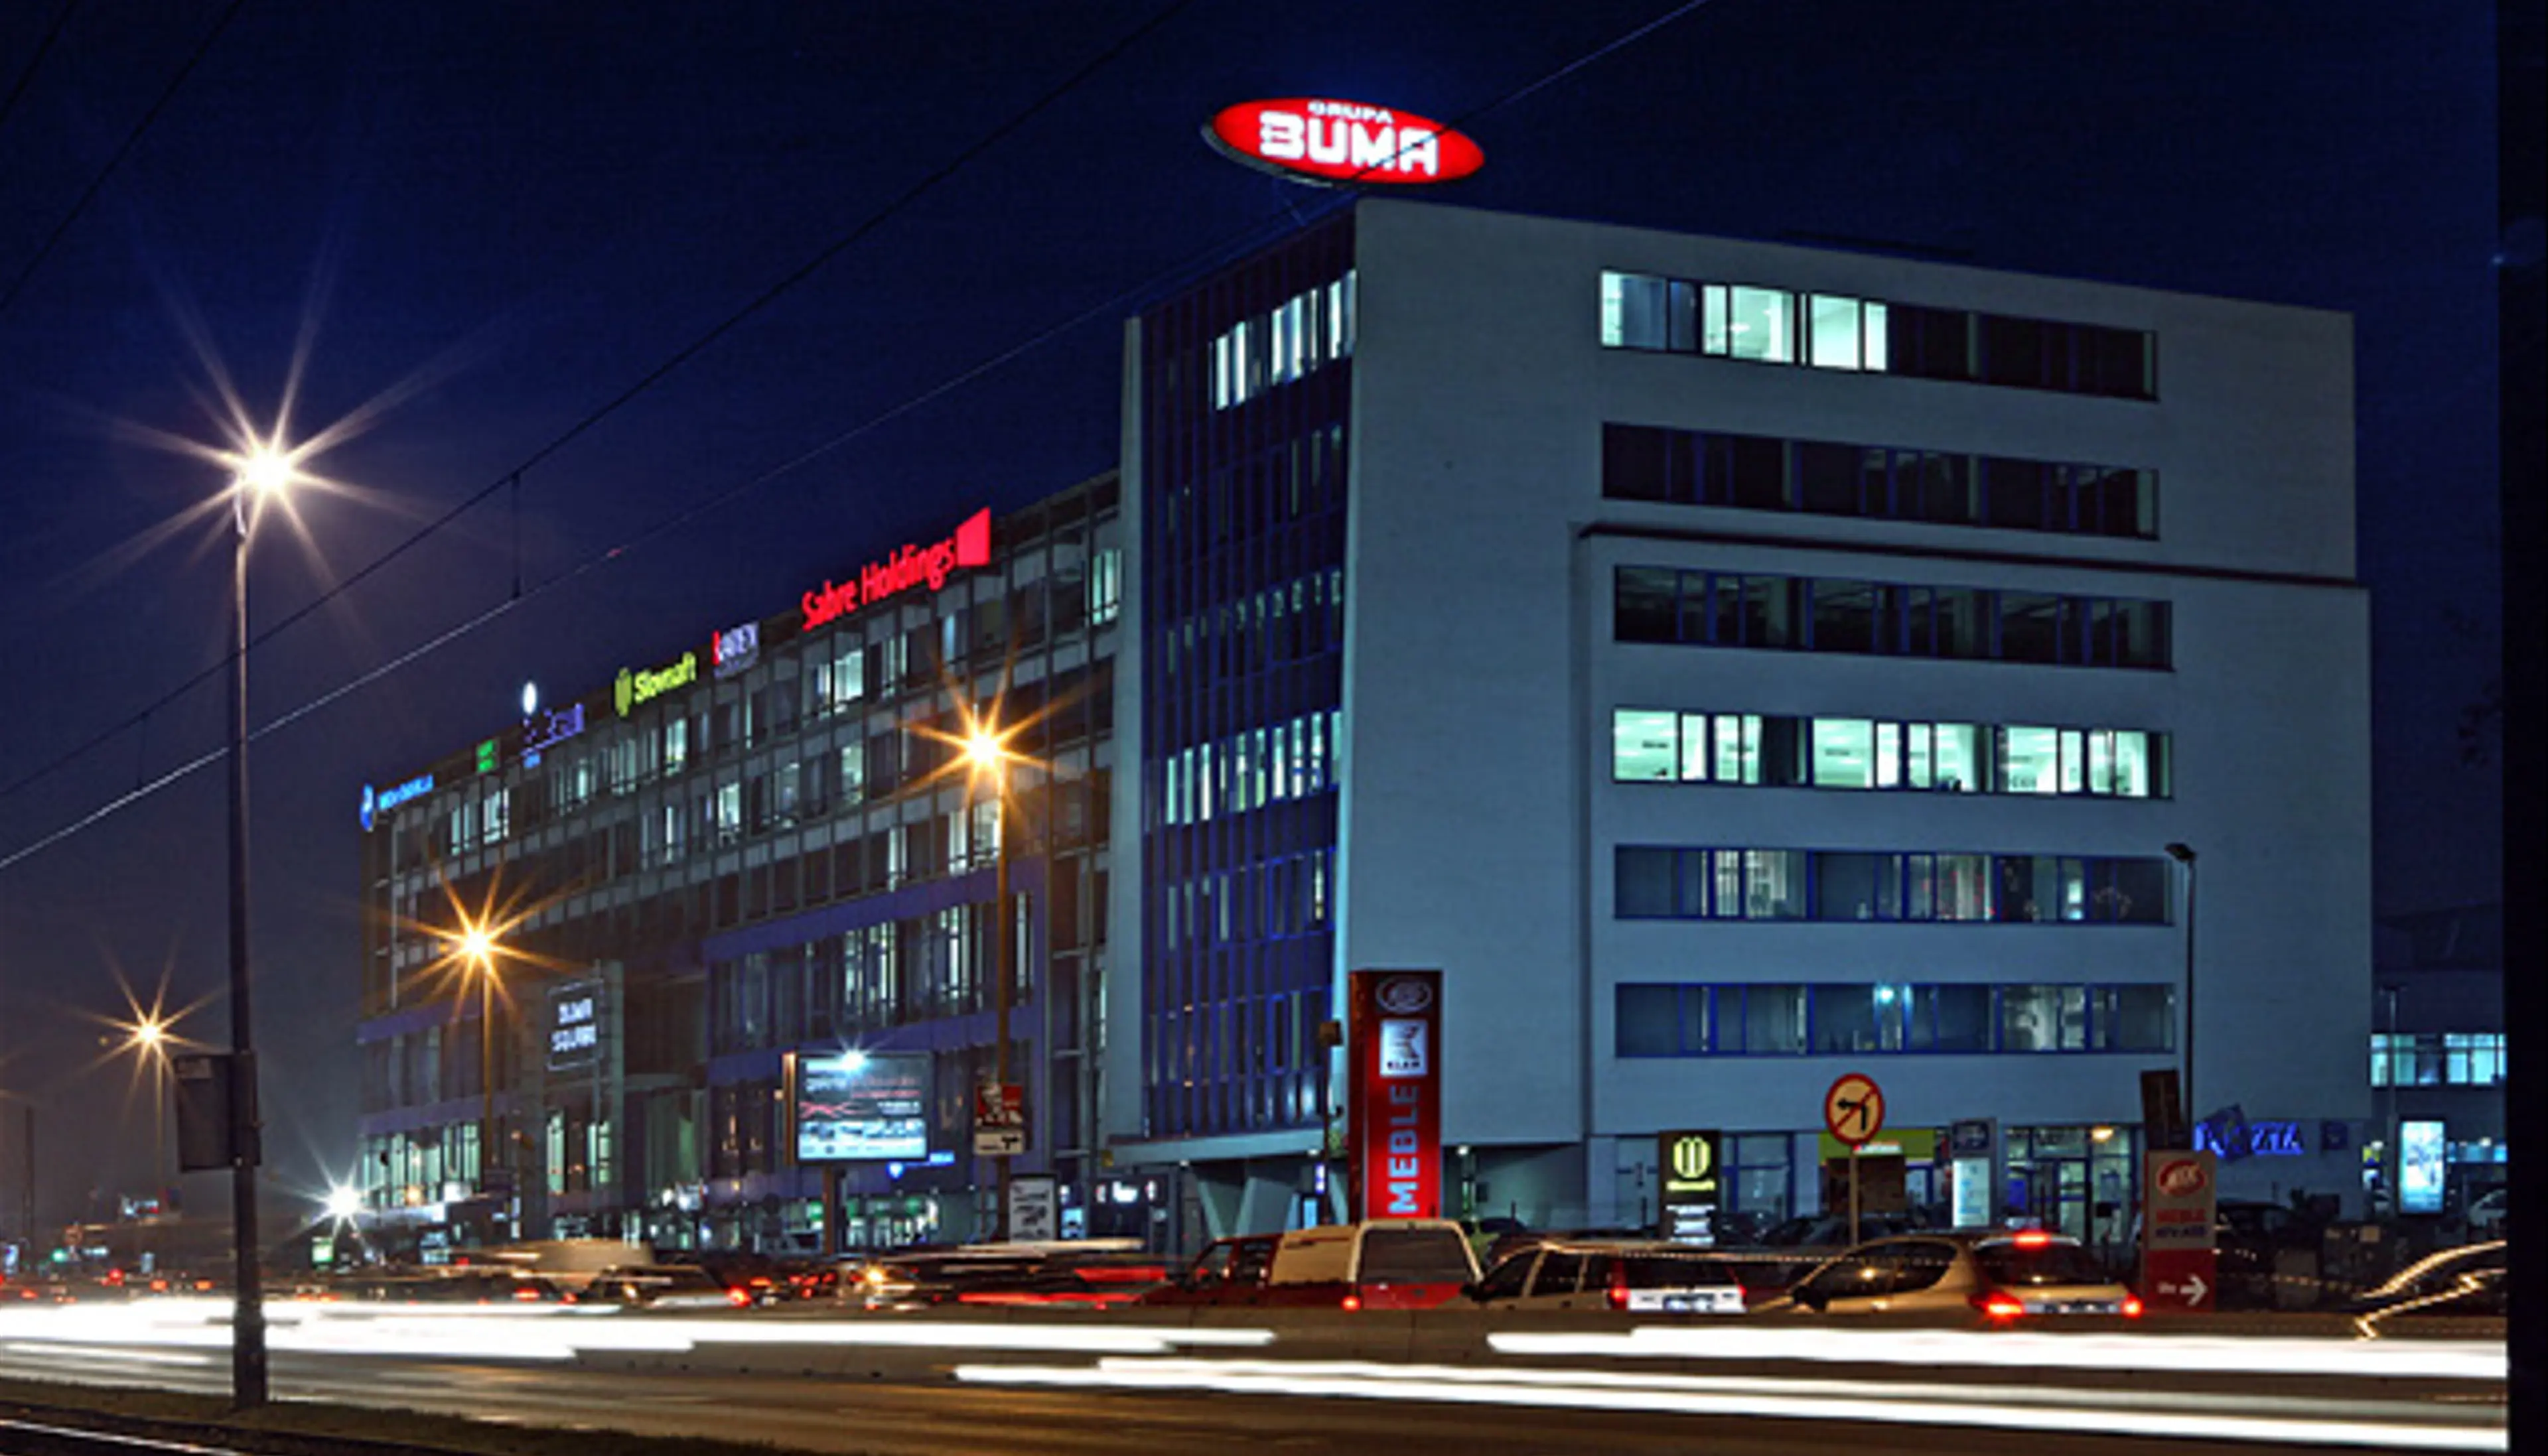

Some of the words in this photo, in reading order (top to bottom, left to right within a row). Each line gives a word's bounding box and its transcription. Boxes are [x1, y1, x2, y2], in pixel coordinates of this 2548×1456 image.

[1259, 110, 1439, 176] BUMA
[1308, 100, 1393, 123] GRUPA
[802, 579, 858, 632] Sabre
[861, 536, 956, 604] Holdings
[1389, 1085, 1419, 1213] MEBLE
